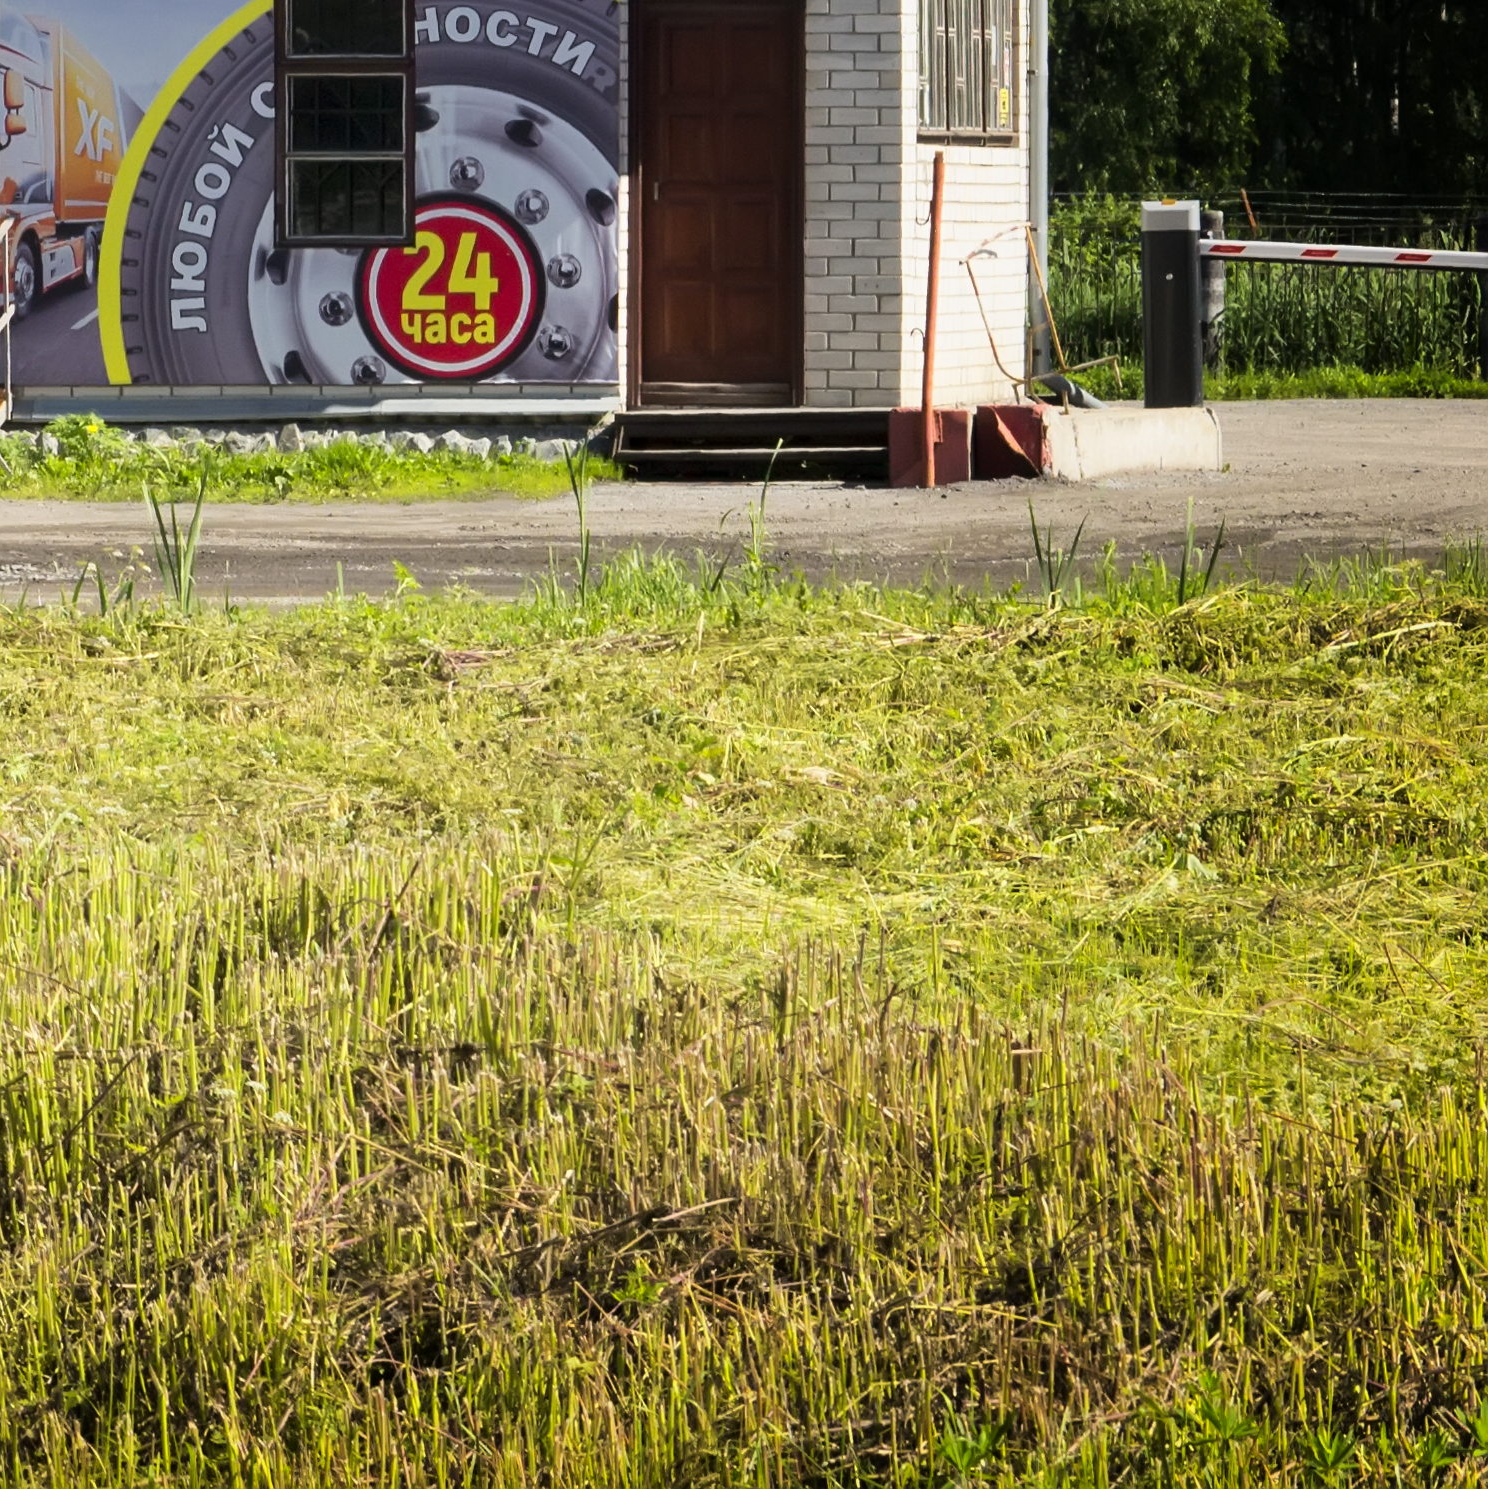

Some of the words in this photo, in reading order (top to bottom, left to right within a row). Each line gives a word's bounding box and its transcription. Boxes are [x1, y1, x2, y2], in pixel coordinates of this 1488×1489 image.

[170, 122, 255, 333] ЛЮБОЙ
[401, 231, 499, 310] 24
[401, 310, 495, 345] часа
